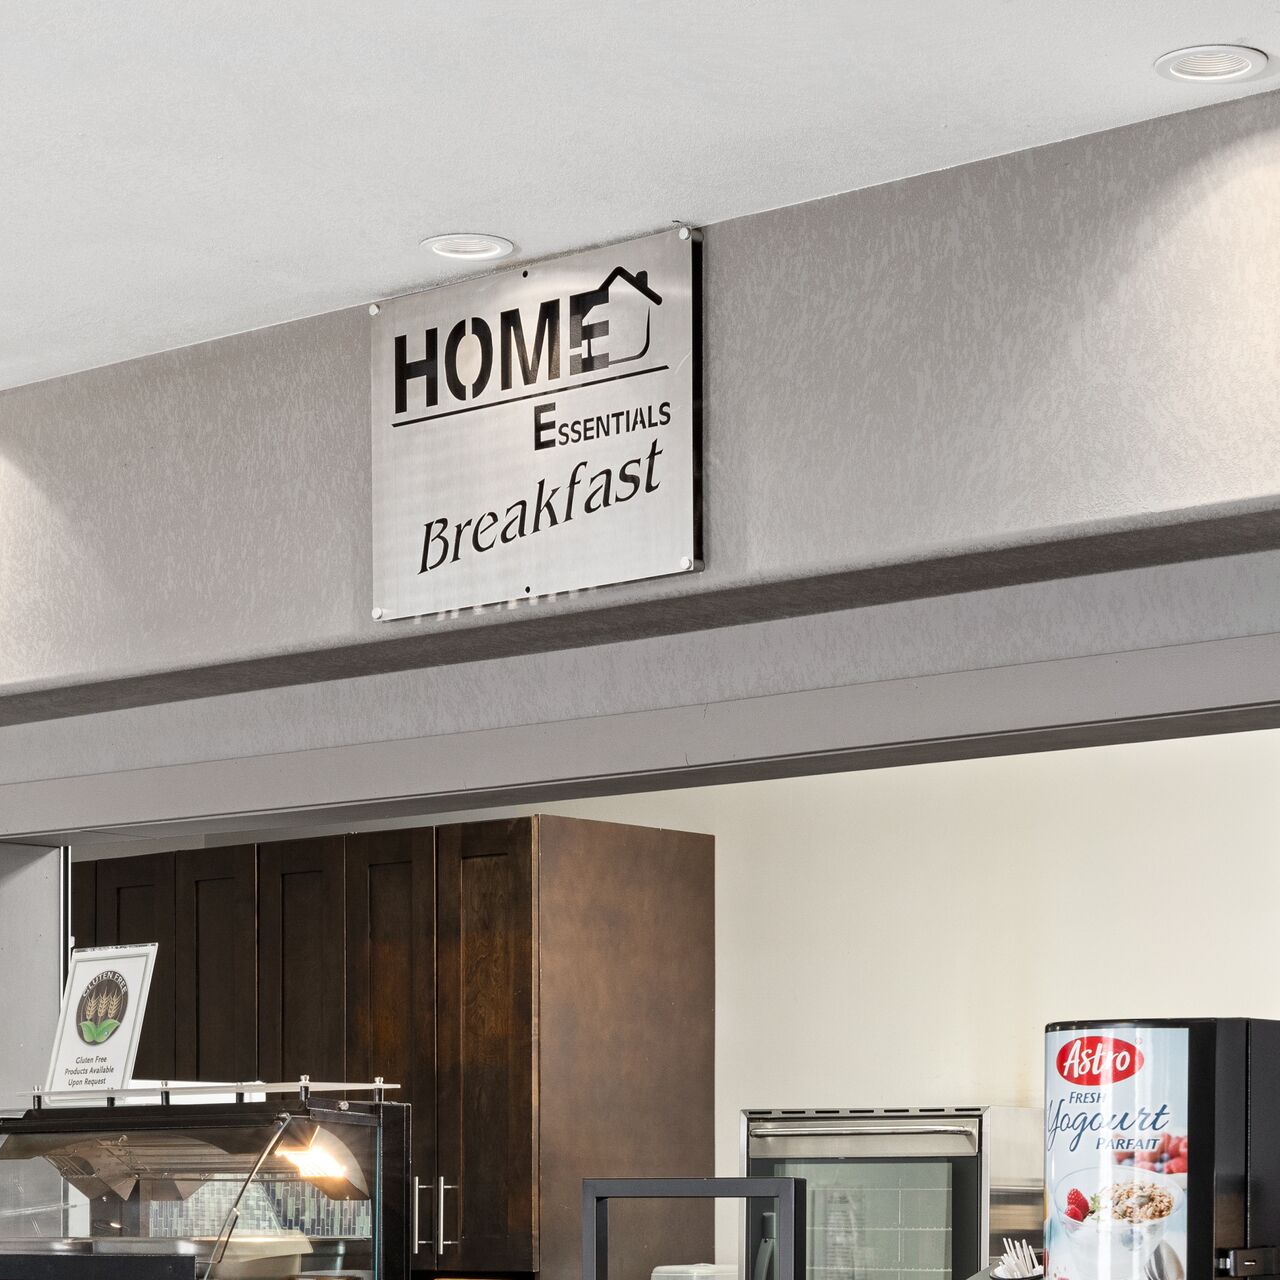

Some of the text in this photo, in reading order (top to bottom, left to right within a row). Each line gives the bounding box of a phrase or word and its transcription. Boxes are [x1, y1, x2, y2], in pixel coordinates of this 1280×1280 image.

[394, 288, 610, 414] HOME
[417, 438, 664, 575] Breakfast
[82, 971, 128, 997] GLUTEN FREE
[75, 1055, 107, 1064] Gluten Free
[1062, 1039, 1131, 1078] Astro
[65, 1066, 115, 1076] Products Available
[68, 1077, 106, 1088] Upon Request
[1069, 1091, 1106, 1104] FRESH
[1047, 1098, 1171, 1153] Yogourt
[1096, 1137, 1160, 1150] PARFAIT
